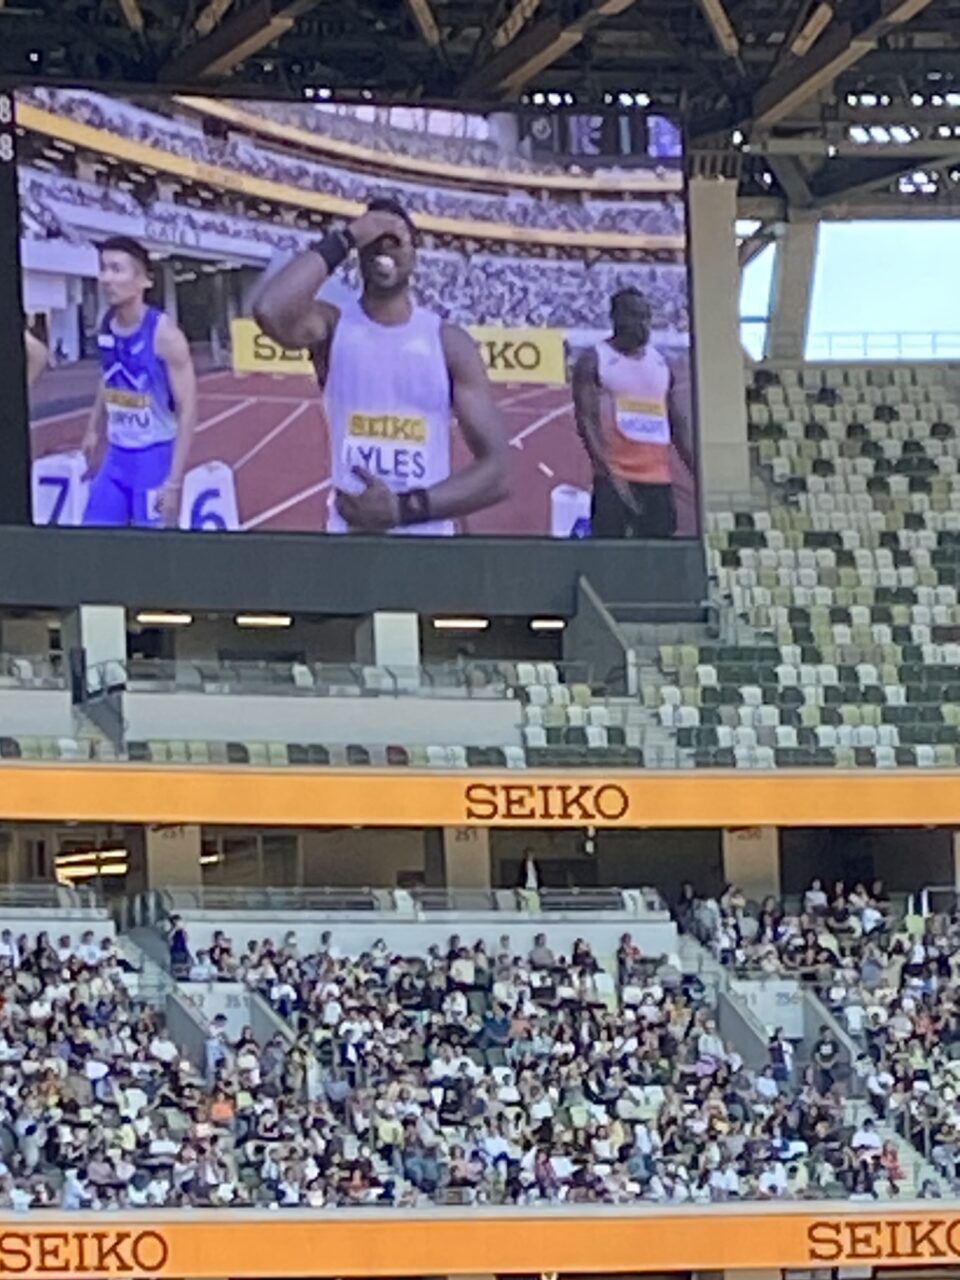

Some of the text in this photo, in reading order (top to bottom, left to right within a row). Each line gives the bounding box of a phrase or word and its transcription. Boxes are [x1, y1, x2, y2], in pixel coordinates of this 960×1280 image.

[38, 476, 70, 526] 7
[191, 488, 227, 531] 6
[464, 783, 630, 820] SEIKO
